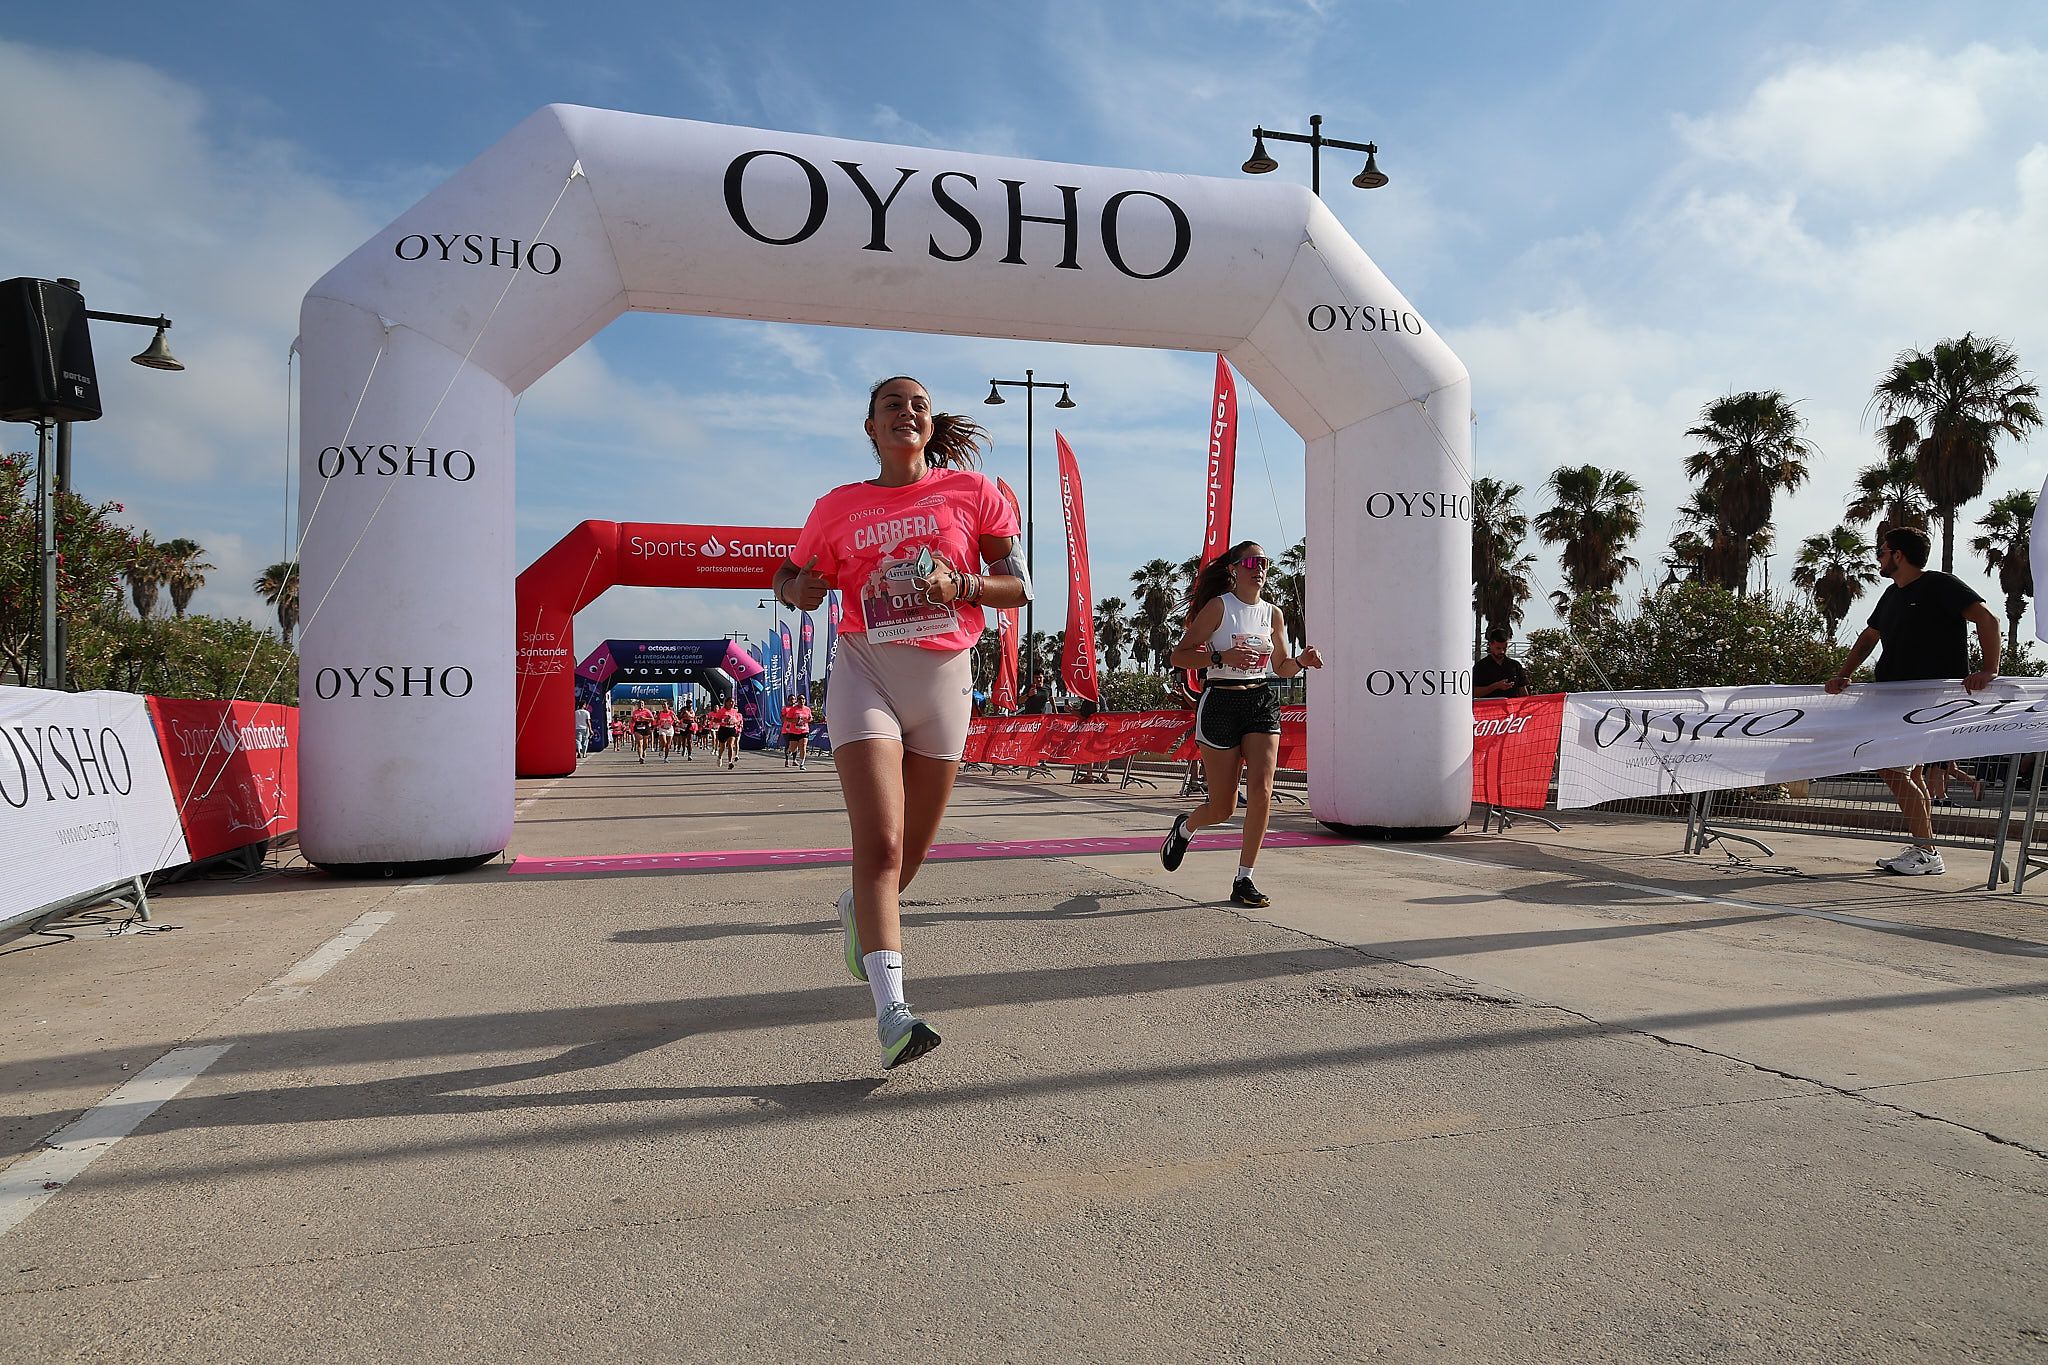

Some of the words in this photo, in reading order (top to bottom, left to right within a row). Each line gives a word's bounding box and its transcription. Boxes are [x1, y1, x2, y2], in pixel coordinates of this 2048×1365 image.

[723, 150, 1192, 279] OYSHO
[395, 234, 562, 275] OYSHO
[1308, 304, 1421, 335] OYSHO
[318, 444, 476, 482] OYSHO
[849, 508, 885, 522] OYSHO
[1366, 492, 1470, 521] OYSHO
[854, 515, 940, 550] CARRERA
[631, 536, 697, 560] Sports
[729, 540, 797, 558] Santan
[697, 565, 764, 574] sportssantander.es
[523, 631, 555, 643] Sports
[877, 628, 906, 638] OYSHO
[520, 647, 568, 657] Santander
[315, 666, 473, 699] OYSHO
[1366, 670, 1471, 696] OYSHO
[1473, 714, 1533, 737] ander
[1594, 706, 1805, 749] OYSHO
[171, 719, 221, 766] Sports
[232, 719, 288, 751] Santander
